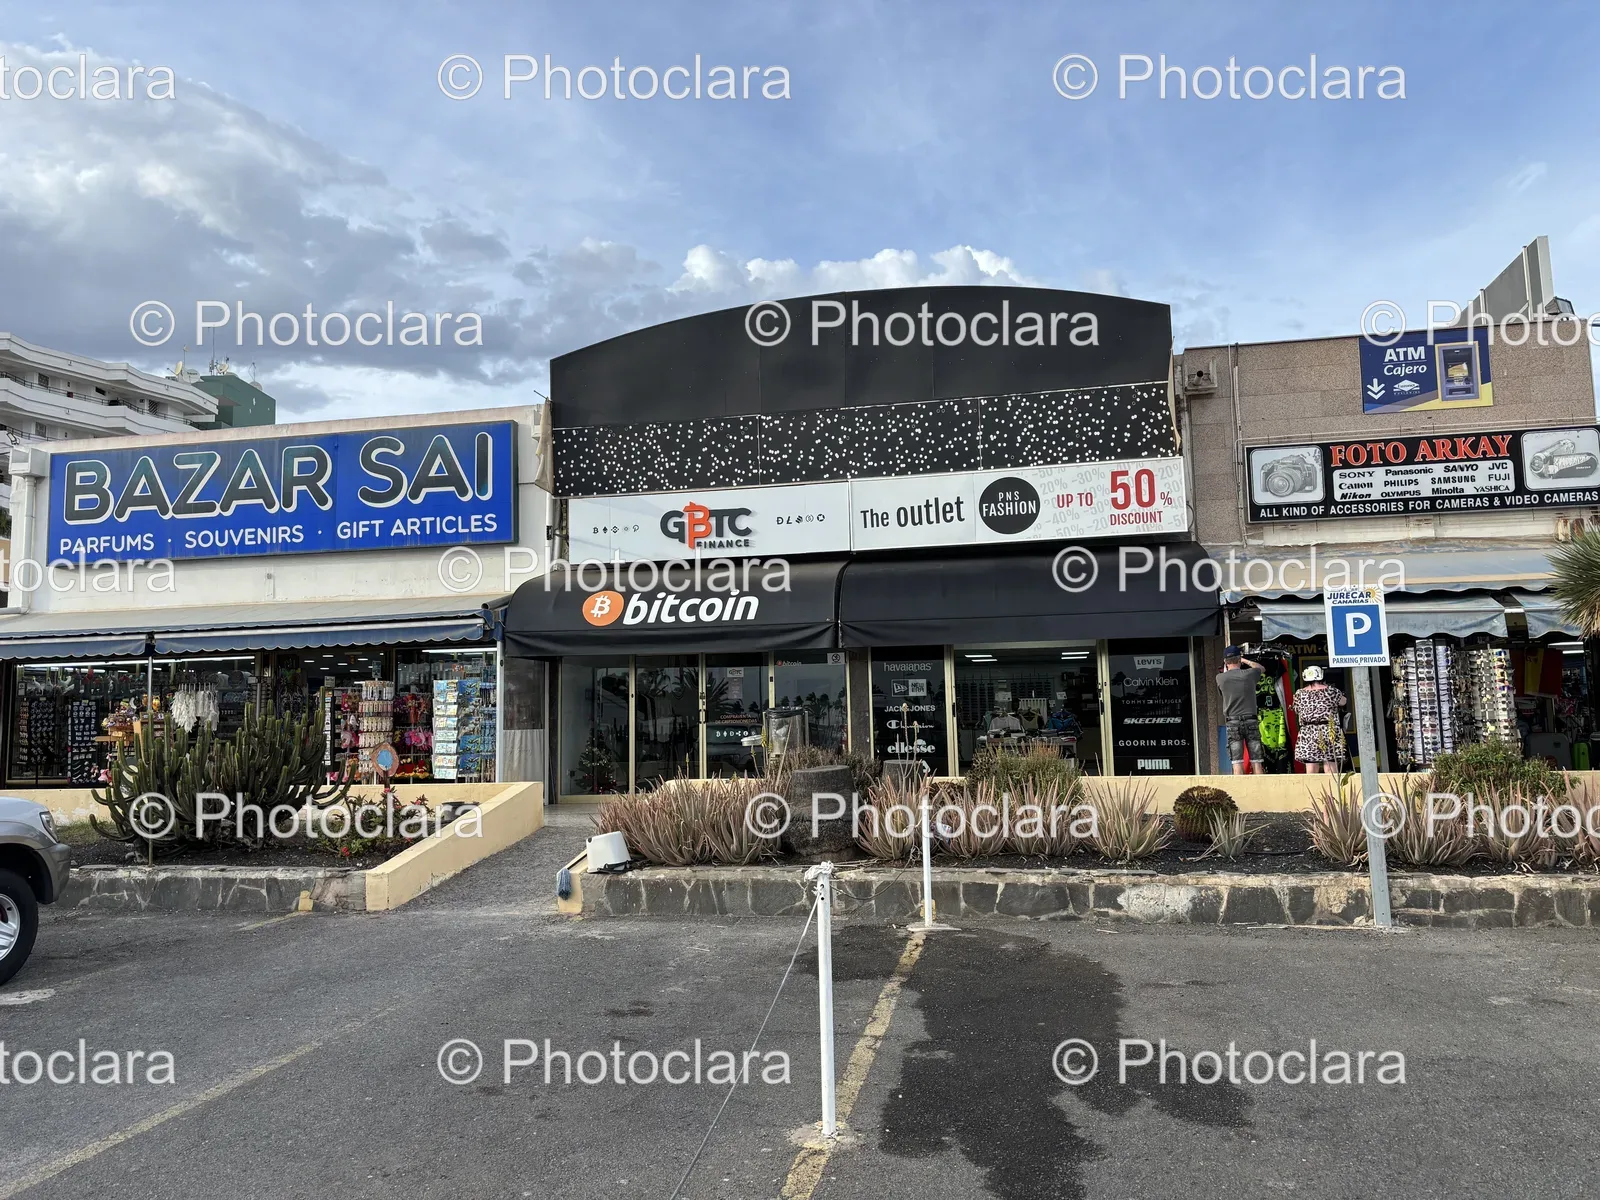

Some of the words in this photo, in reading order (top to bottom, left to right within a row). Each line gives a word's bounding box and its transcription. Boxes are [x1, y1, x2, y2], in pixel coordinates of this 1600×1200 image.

[1384, 346, 1425, 362] ATM
[1383, 364, 1427, 377] Cajero
[1330, 441, 1407, 467] FOTO
[1414, 434, 1512, 462] ARKAY
[64, 444, 333, 525] BAZAR
[358, 431, 493, 508] SAI
[1339, 471, 1375, 479] SONY
[1385, 466, 1433, 476] Panasonic
[1443, 464, 1478, 473] SANYO
[1488, 462, 1508, 471] JVC
[1338, 482, 1373, 490] Canon
[1384, 479, 1419, 488] PHILIPS
[1430, 475, 1476, 484] SAMSUNG
[1488, 474, 1510, 482] FUJI
[1056, 494, 1074, 508] UP
[1077, 492, 1094, 507] TO
[1340, 492, 1372, 500] Nikon
[1380, 490, 1422, 498] OLYMPUS
[1432, 487, 1464, 495] Minolta
[860, 508, 890, 528] The
[896, 496, 965, 528] outlet
[982, 500, 1037, 517] FASHION
[1260, 508, 1279, 518] ALL
[1282, 506, 1308, 517] KIND
[1311, 506, 1324, 516] OF
[1330, 502, 1404, 515] ACCESSORIES
[1408, 500, 1431, 511] FOR
[1436, 497, 1490, 509] CAMERAS
[1493, 496, 1500, 506] &
[1504, 494, 1539, 506] VIDEO
[1544, 491, 1599, 503] CAMERAS
[1110, 510, 1163, 526] DISCOUNT
[60, 533, 154, 555] PARFUMS
[185, 525, 304, 549] SOUVENIRS
[337, 519, 384, 540] GIFT
[391, 514, 498, 536] ARTICLES
[696, 539, 750, 548] FINANCE
[1327, 592, 1372, 600] JURECAR
[622, 589, 760, 626] bitcoin
[1346, 612, 1372, 648] P
[884, 662, 932, 672] havaianas
[1360, 656, 1386, 664] PRIVADO
[1123, 678, 1154, 687] Calvin
[1156, 676, 1178, 686] Klein
[1122, 716, 1182, 724] SKECHERS
[887, 742, 936, 754] ellesse
